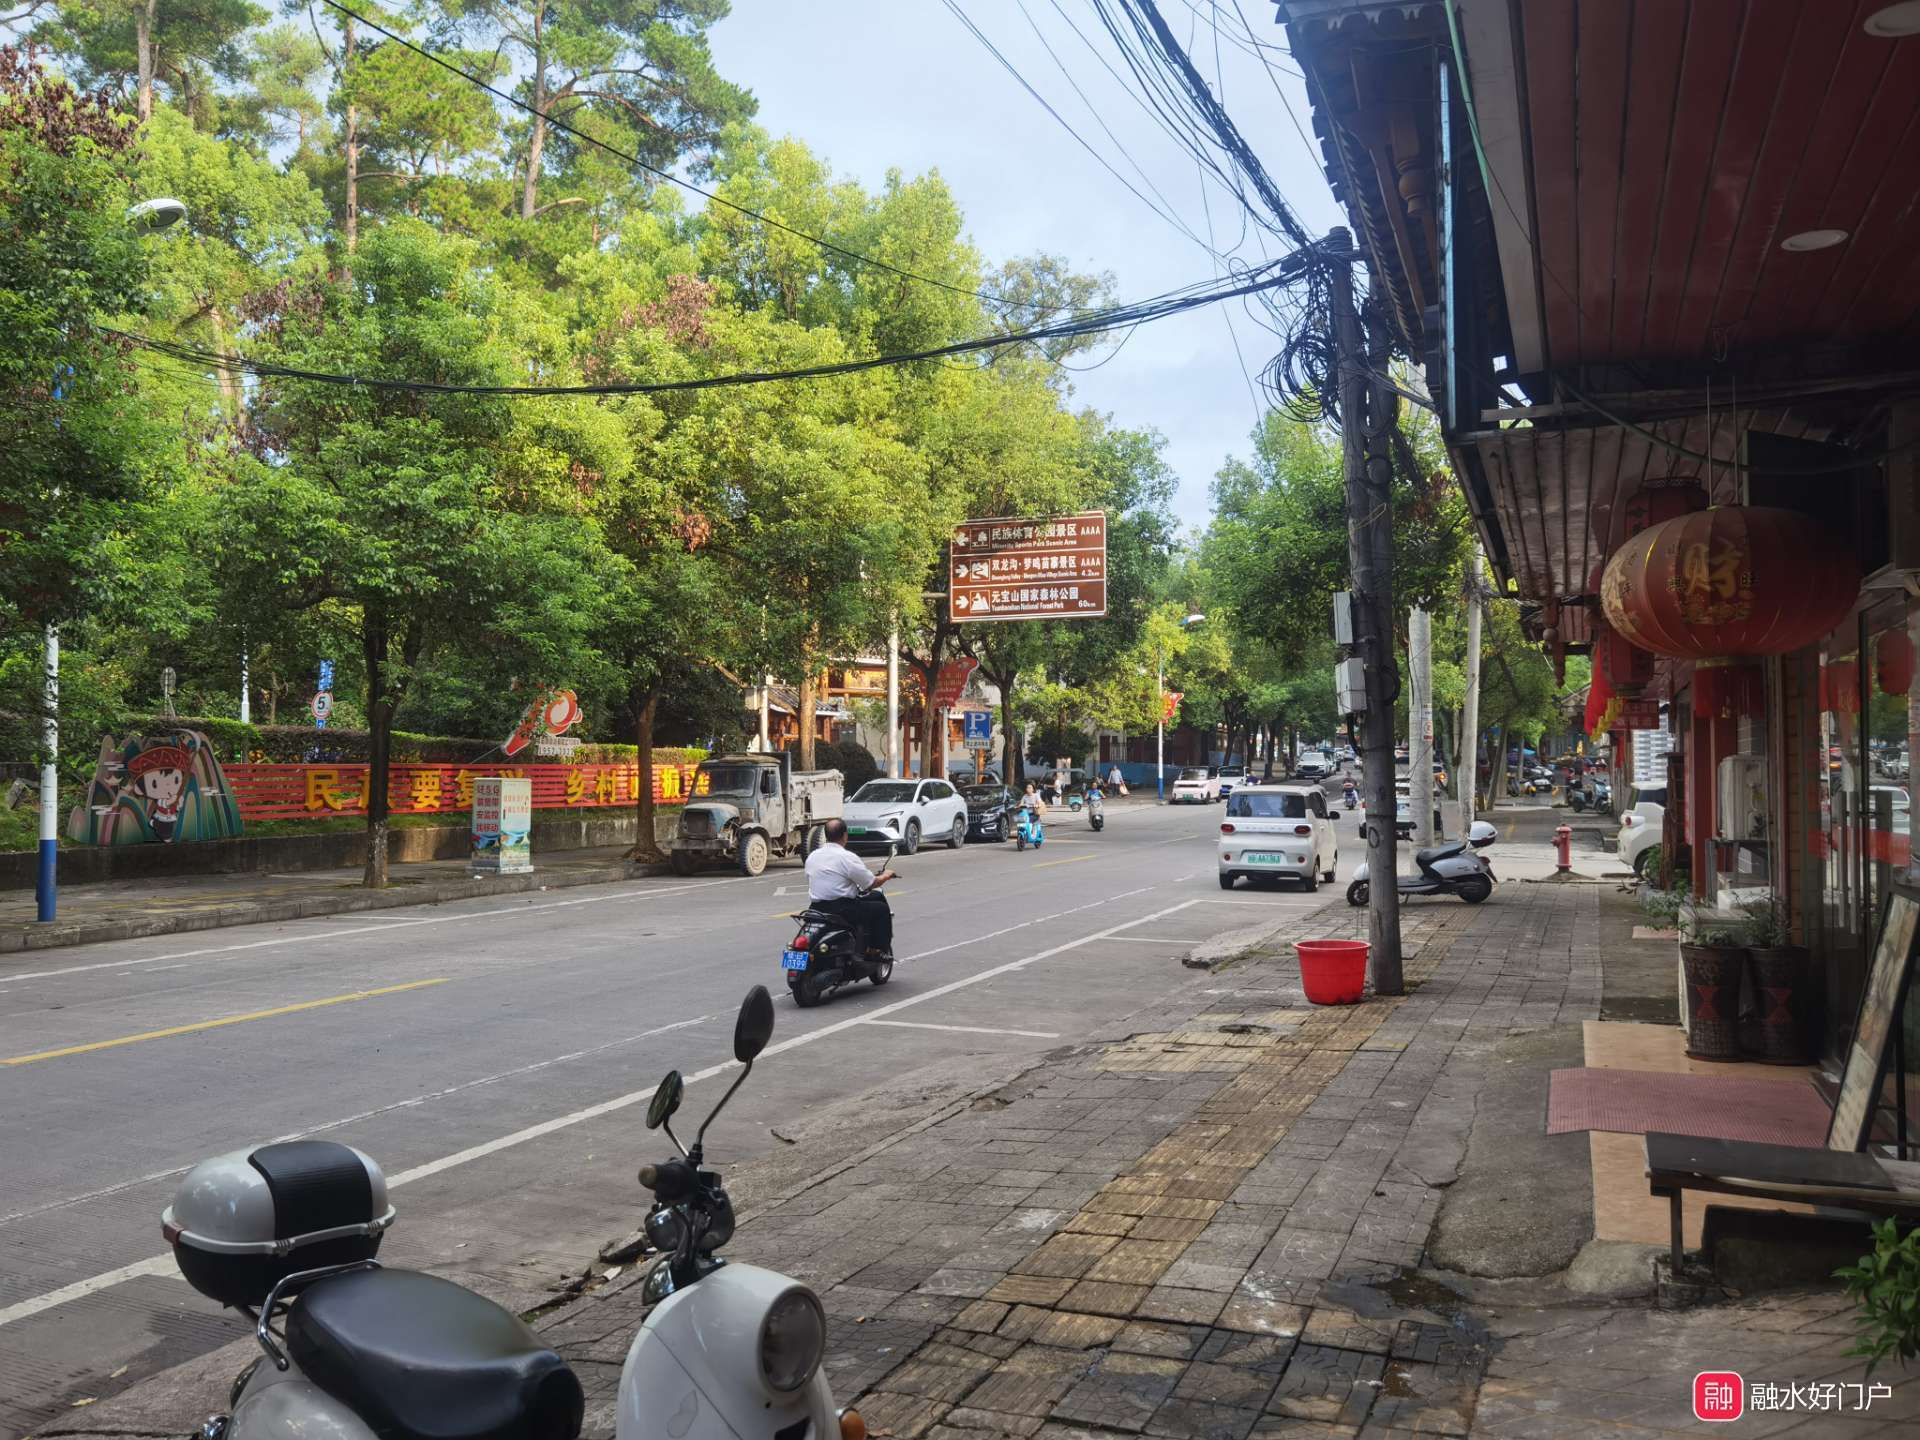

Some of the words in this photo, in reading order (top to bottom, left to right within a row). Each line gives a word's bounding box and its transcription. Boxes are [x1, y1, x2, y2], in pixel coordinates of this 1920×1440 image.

[992, 523, 1077, 540] 民族体育公园景区
[1080, 526, 1101, 536] AAAA
[1080, 557, 1101, 567] AAAA
[992, 587, 1079, 603] 元宝山国家森林公园
[1078, 599, 1096, 608] 60km
[318, 696, 325, 710] 5
[969, 713, 986, 730] P
